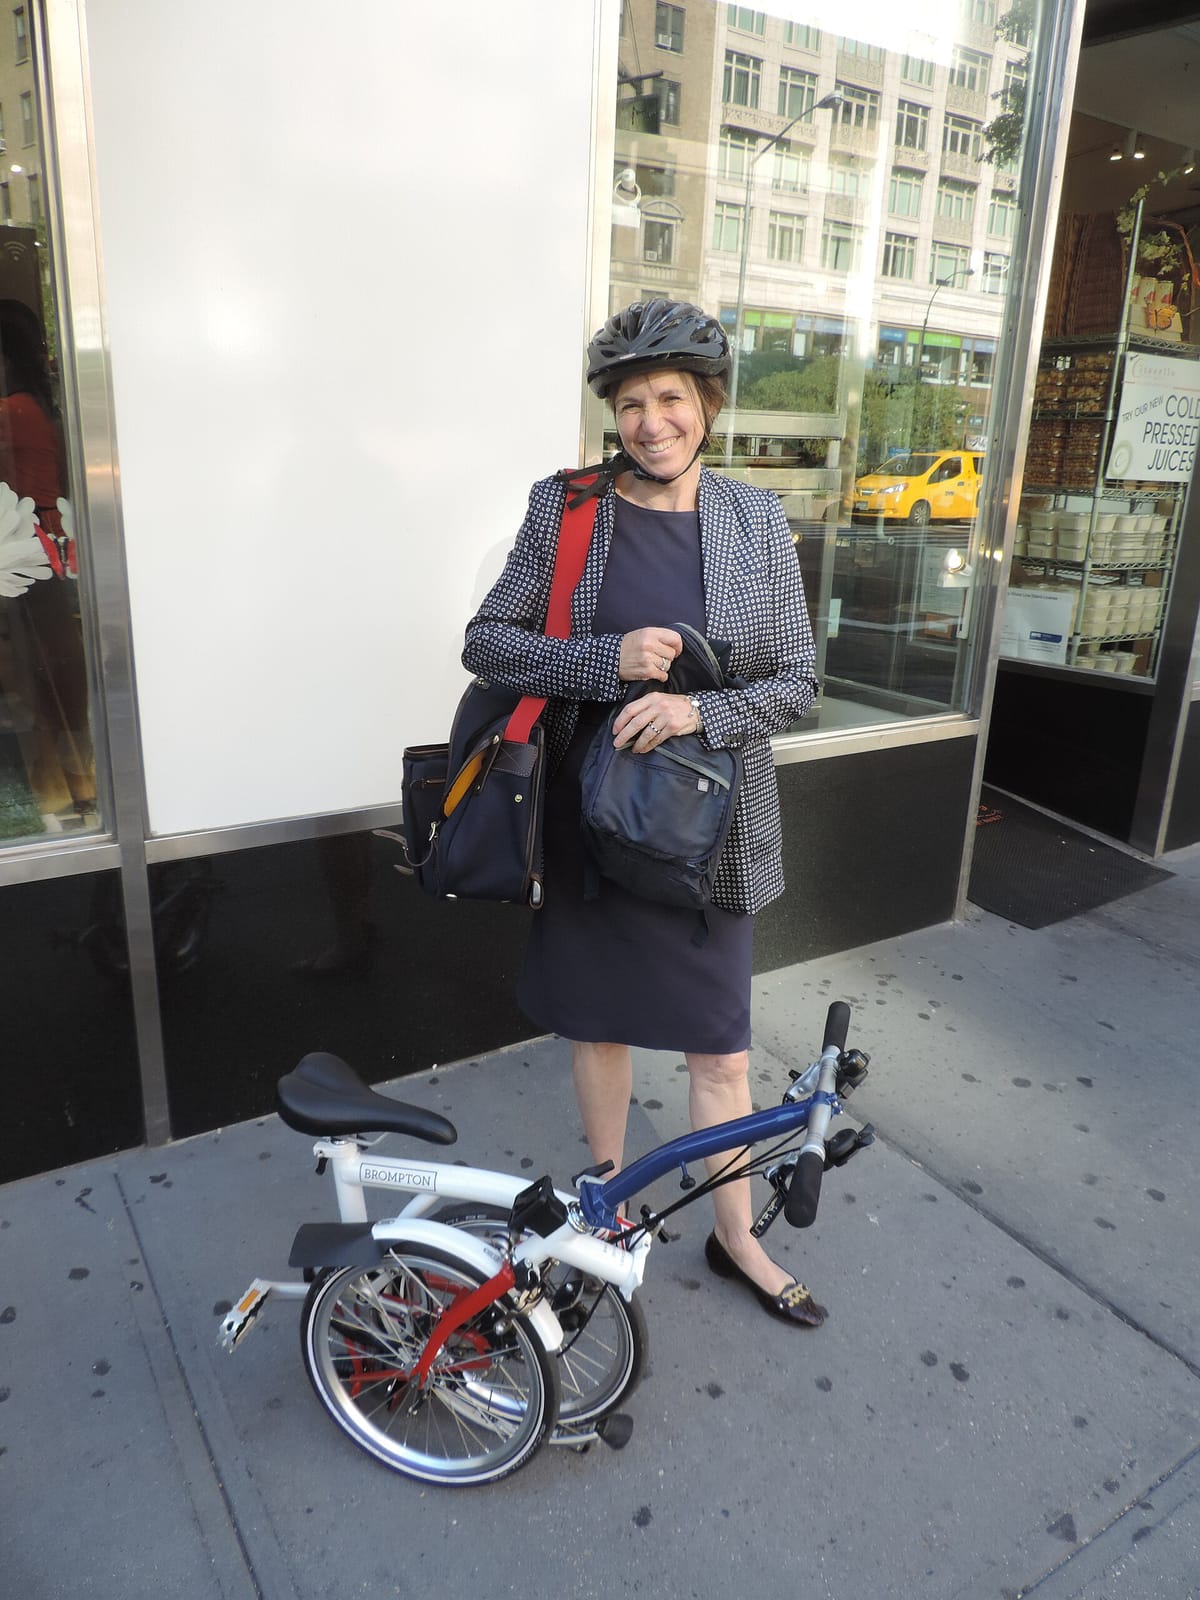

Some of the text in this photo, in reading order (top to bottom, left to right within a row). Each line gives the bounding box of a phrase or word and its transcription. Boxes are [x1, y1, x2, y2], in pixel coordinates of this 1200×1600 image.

[1122, 395, 1163, 422] TRY OUR NEW
[1147, 449, 1195, 472] JUICES
[364, 1168, 431, 1186] BROMPTON
